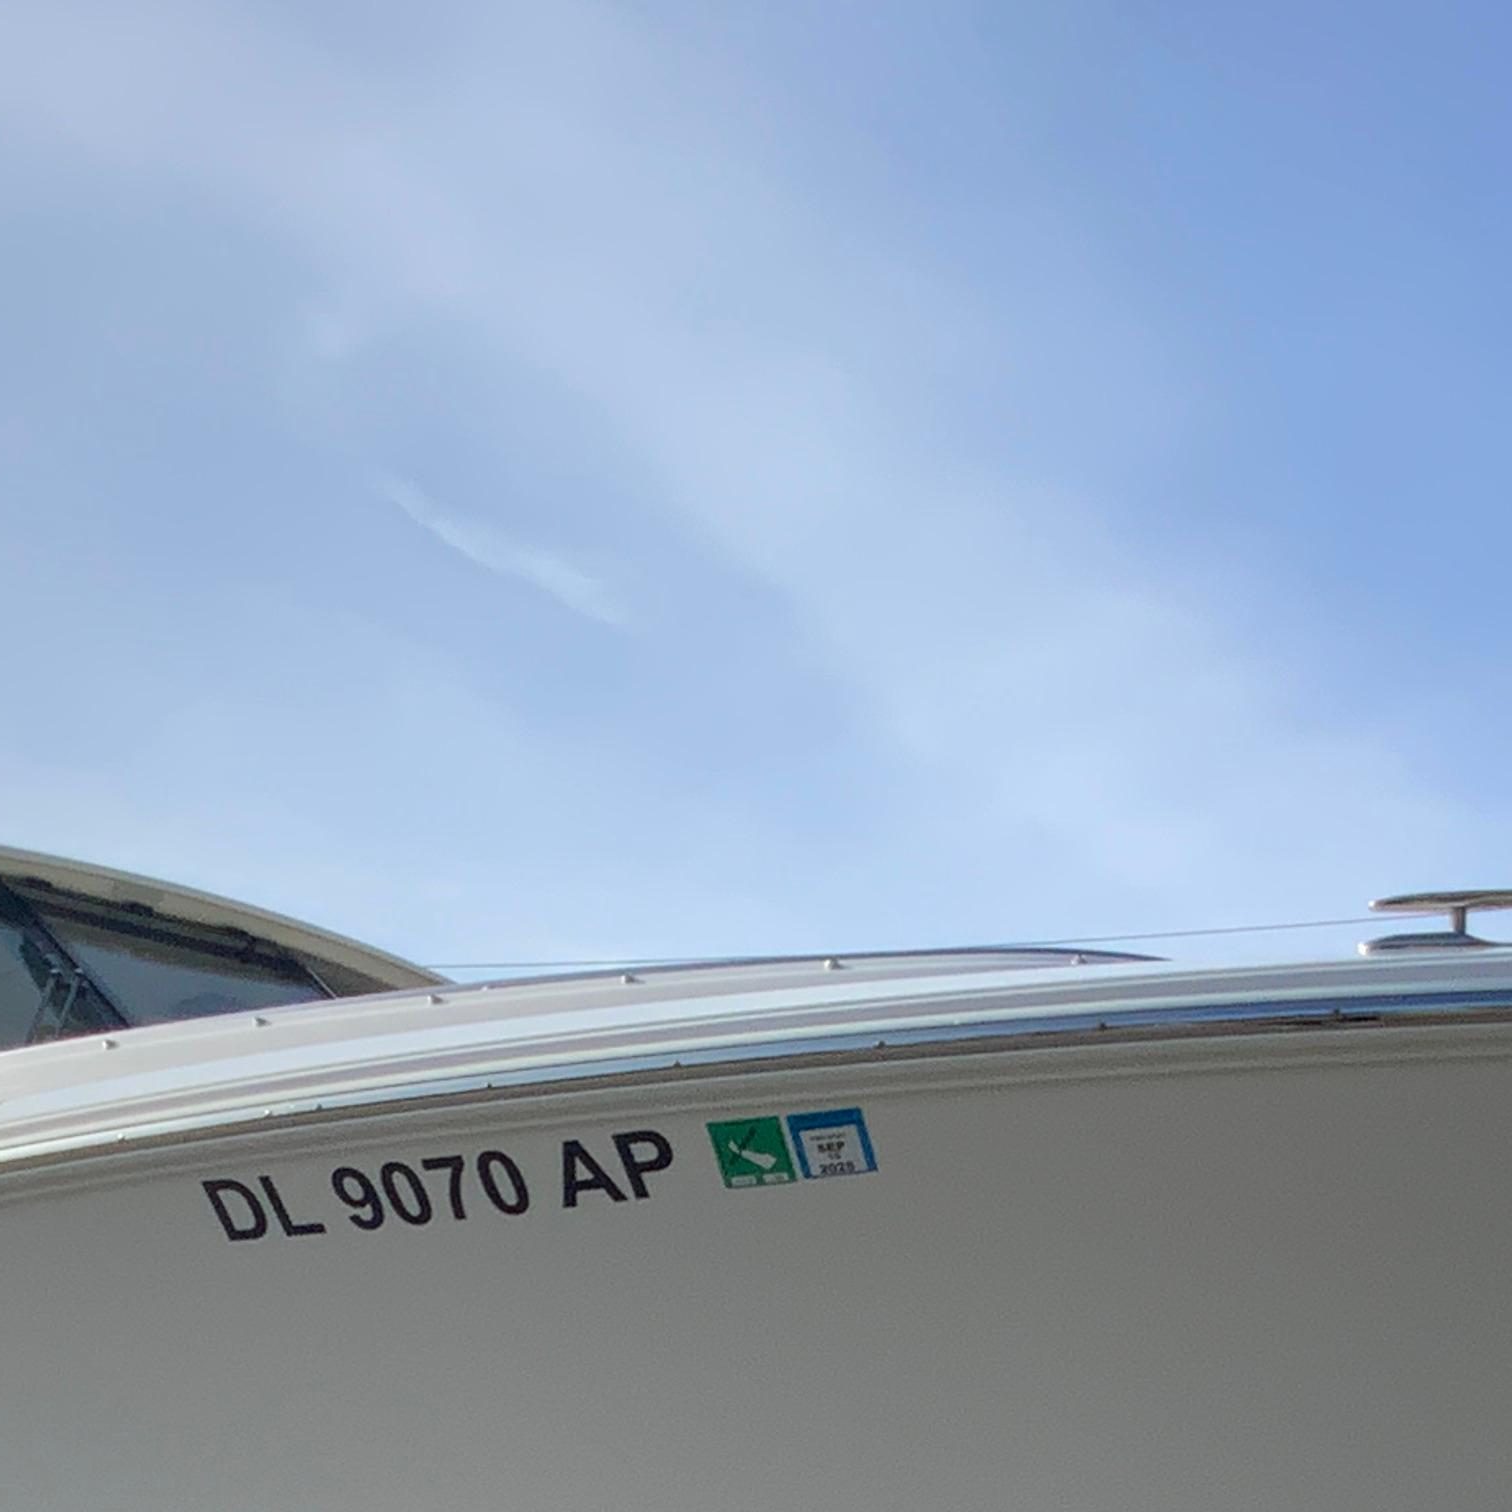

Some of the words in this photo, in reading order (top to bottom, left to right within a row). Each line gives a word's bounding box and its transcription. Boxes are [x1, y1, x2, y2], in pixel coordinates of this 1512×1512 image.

[201, 1174, 327, 1242] DL
[331, 1151, 530, 1231] 9070
[562, 1130, 674, 1209] AP
